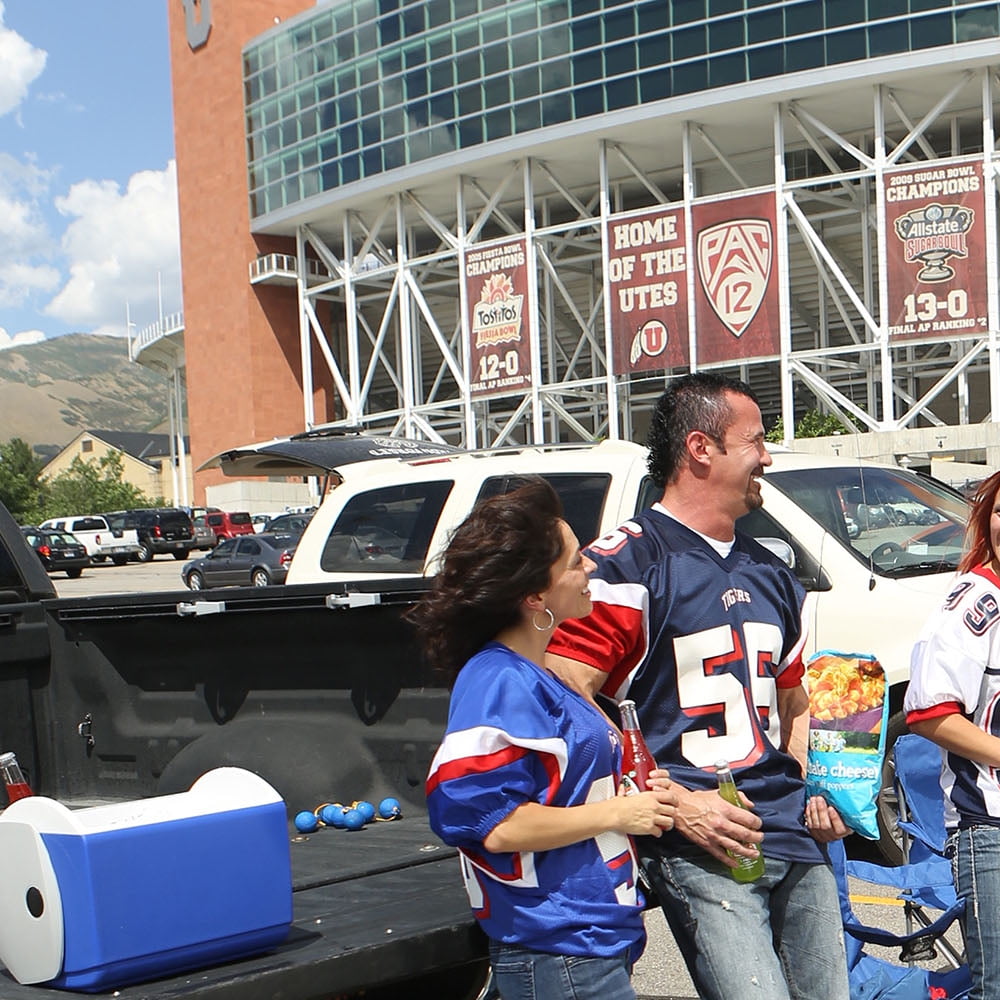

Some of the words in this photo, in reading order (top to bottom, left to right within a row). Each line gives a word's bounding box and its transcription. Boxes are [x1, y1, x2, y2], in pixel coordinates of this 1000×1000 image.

[886, 176, 980, 203] CHAMPIONS
[890, 174, 913, 186] 2009
[914, 170, 946, 183] SUGAR
[947, 166, 975, 178] BOWL
[613, 215, 678, 250] HOME
[907, 220, 960, 238] Allstate
[504, 243, 522, 255] BOWL
[701, 224, 769, 296] PAC
[466, 252, 525, 277] CHAMPIONS
[609, 255, 636, 283] OF
[641, 246, 686, 277] THE
[618, 280, 678, 313] UTES
[724, 281, 753, 314] 12
[904, 289, 968, 323] 13-0
[644, 326, 663, 352] U
[888, 322, 916, 336] FINAL
[917, 320, 931, 333] AP
[932, 317, 975, 331] RANKING
[479, 349, 519, 381] 12-0
